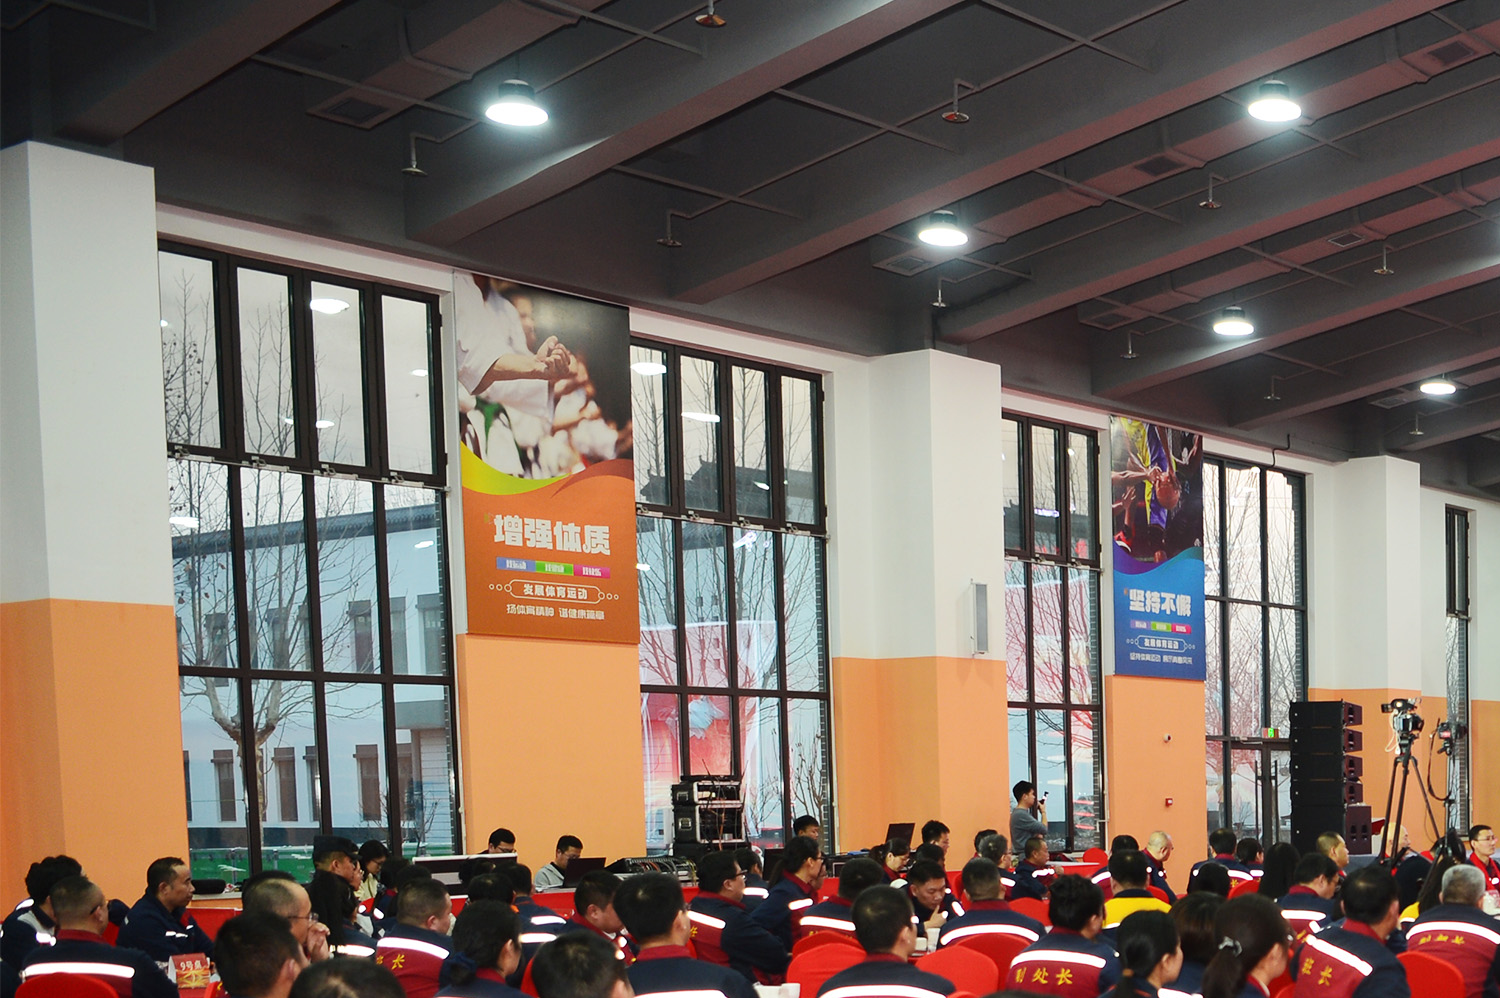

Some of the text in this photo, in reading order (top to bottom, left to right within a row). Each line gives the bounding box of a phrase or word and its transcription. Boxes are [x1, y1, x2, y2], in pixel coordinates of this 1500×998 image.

[494, 514, 611, 555] 增强体质
[523, 584, 588, 599] 发展体育运动
[1015, 967, 1073, 986] 副处长
